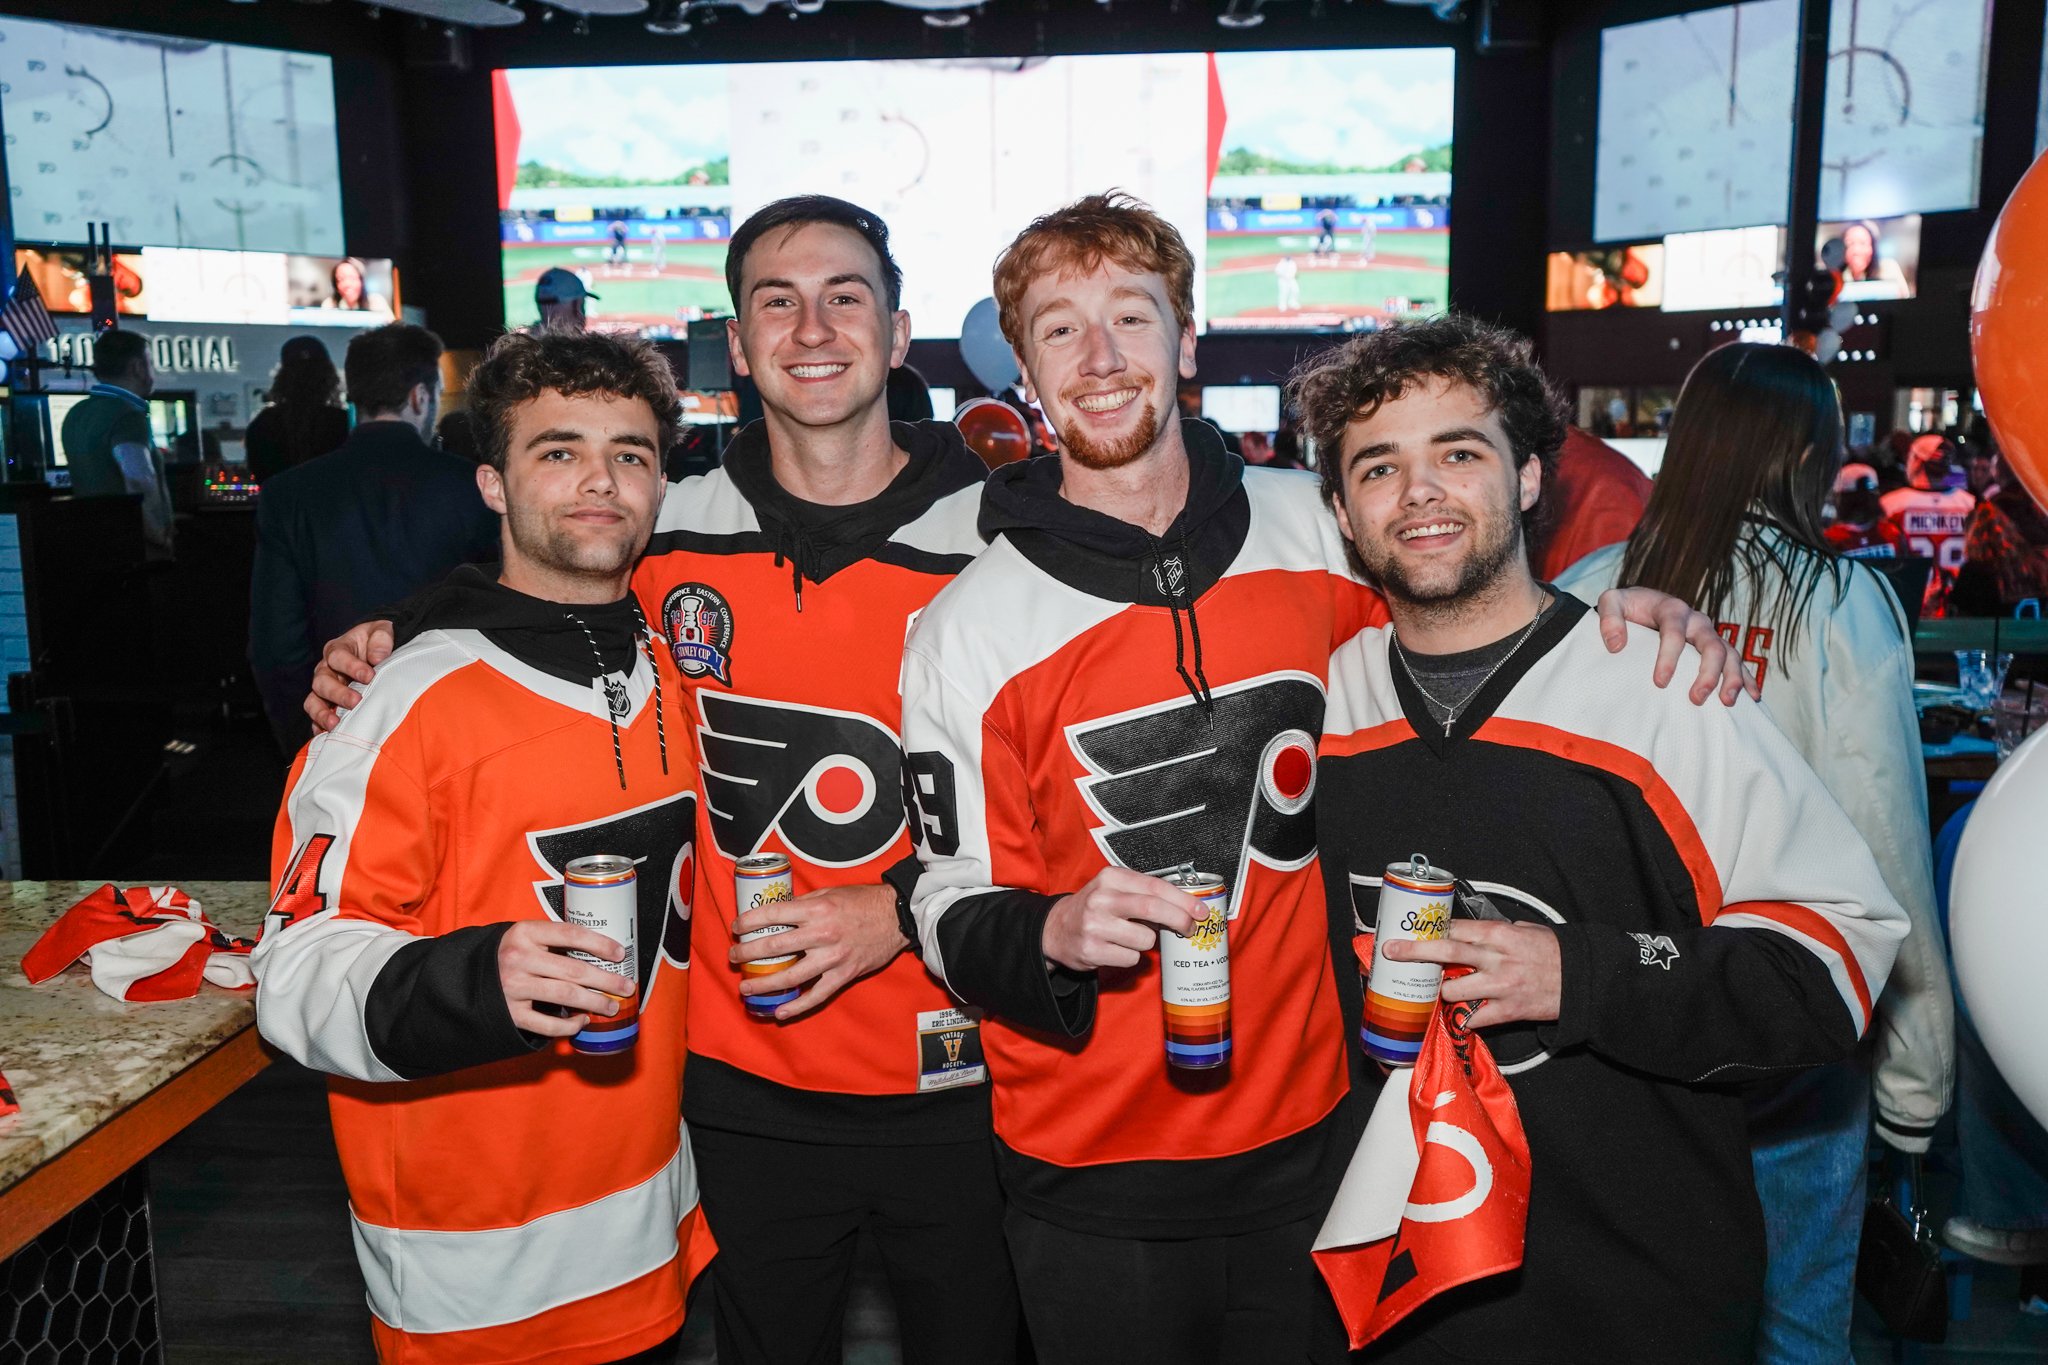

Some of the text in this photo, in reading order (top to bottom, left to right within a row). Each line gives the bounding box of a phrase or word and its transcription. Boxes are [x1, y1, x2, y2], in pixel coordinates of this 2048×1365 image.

[150, 334, 240, 373] OCIAL
[664, 587, 691, 612] CONFERENCE
[696, 588, 731, 648] EASTERN CONFERENCE
[701, 611, 718, 626] 97
[677, 646, 711, 660] STANLEY CUP
[564, 915, 608, 926] ATESIDE
[767, 926, 780, 934] TEA
[1173, 960, 1191, 968] ICED
[1216, 955, 1228, 965] VOD
[932, 1016, 971, 1028] ERIC LINDRO
[940, 1032, 965, 1041] VINTAGE
[942, 1060, 964, 1069] HOCKEY
